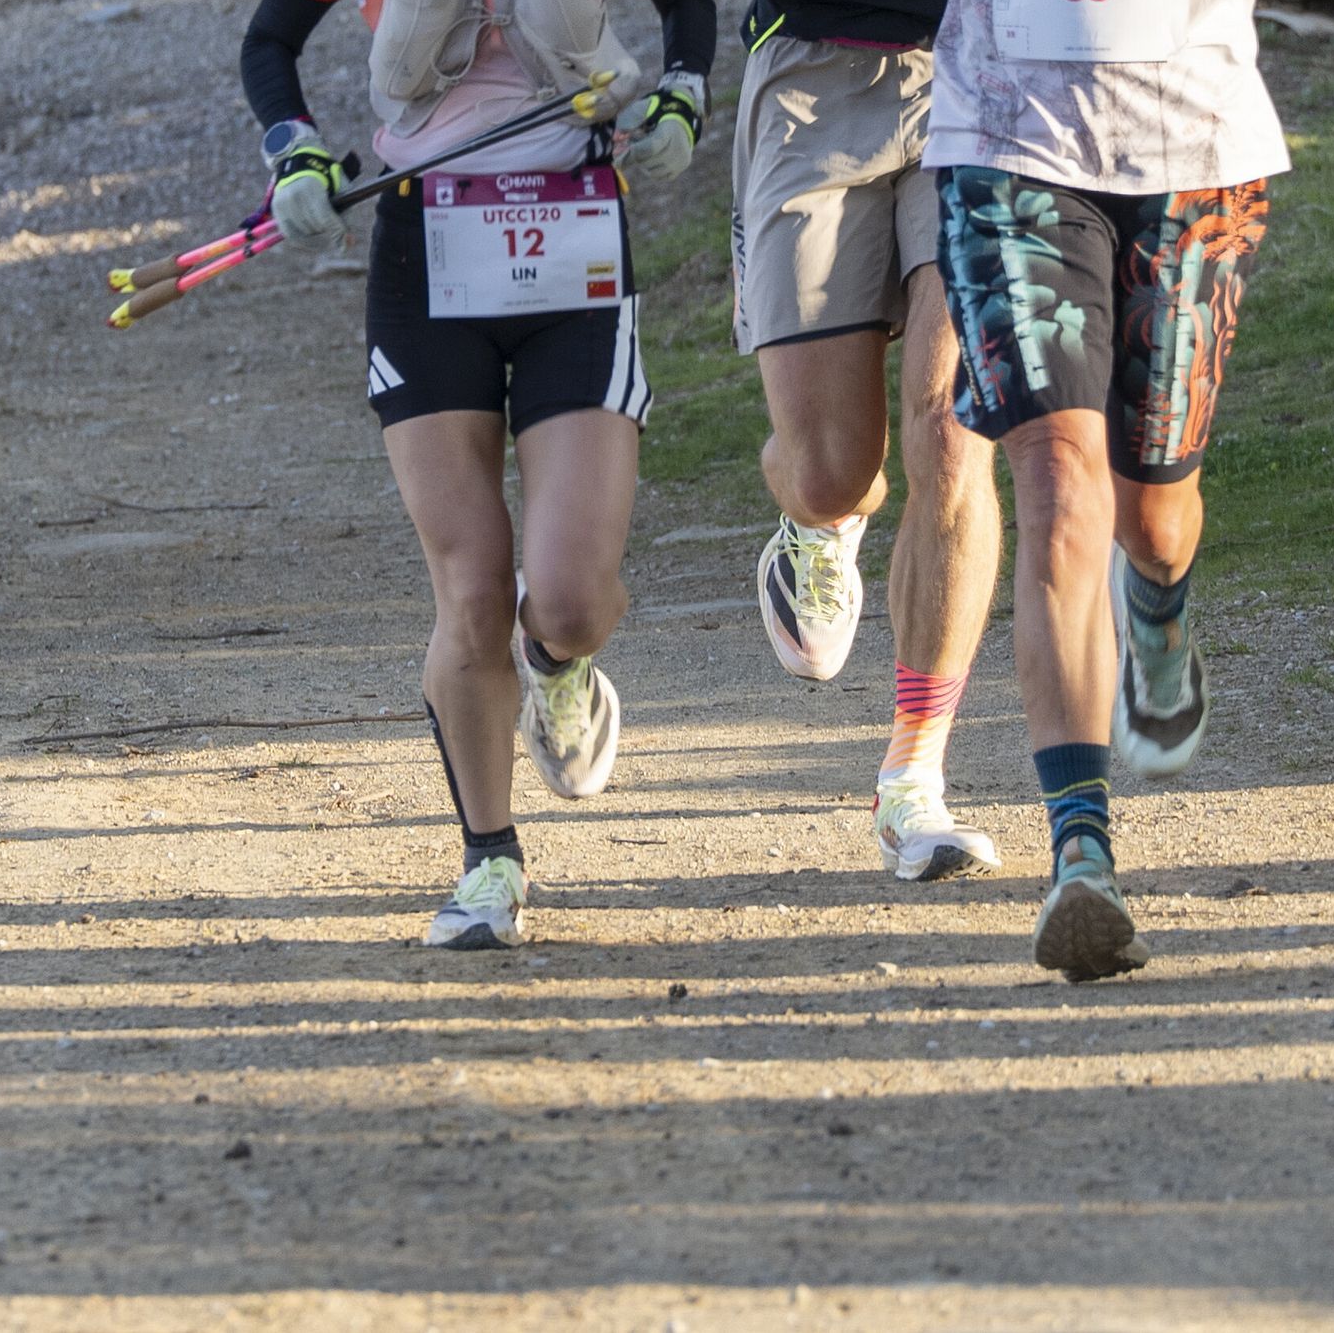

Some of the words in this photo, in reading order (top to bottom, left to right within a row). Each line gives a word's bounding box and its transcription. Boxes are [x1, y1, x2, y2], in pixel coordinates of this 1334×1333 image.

[482, 207, 561, 224] UTCC120
[502, 227, 545, 258] 12
[512, 267, 537, 281] LIN
